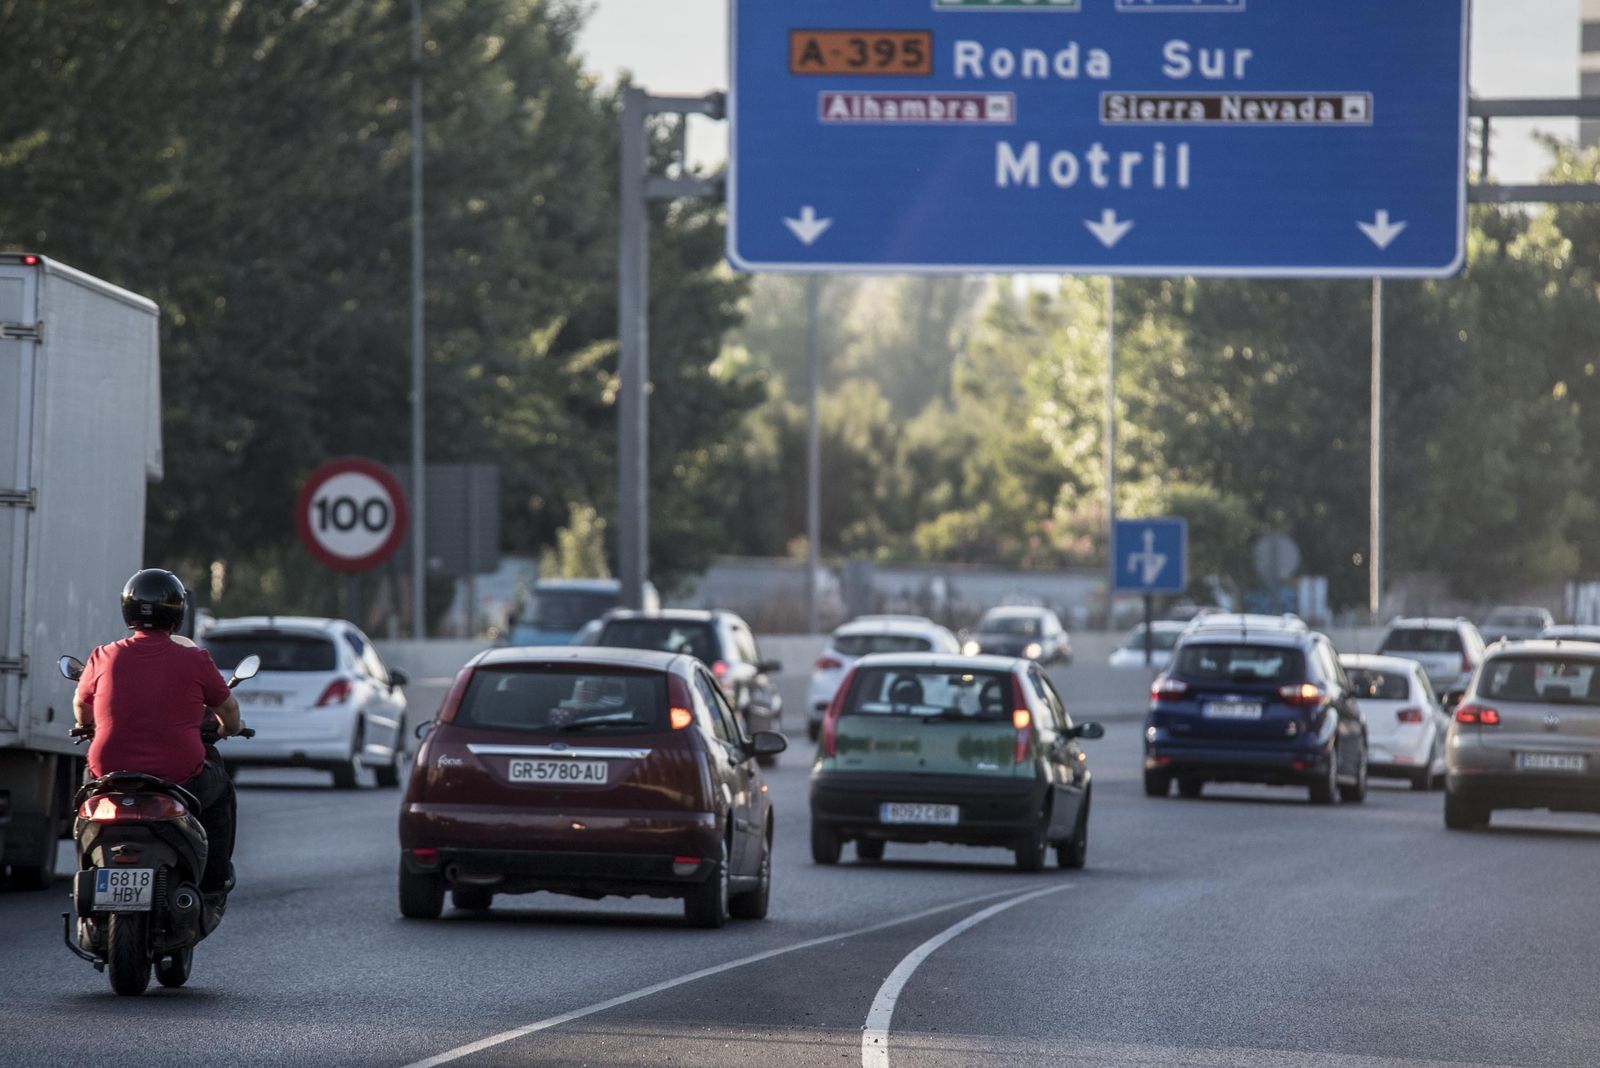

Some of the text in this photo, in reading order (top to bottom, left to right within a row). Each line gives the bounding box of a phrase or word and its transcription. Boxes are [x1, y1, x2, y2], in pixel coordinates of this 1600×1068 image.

[799, 37, 925, 68] A-395
[953, 39, 1252, 79] Ronda Sur
[827, 94, 980, 119] Alhambra
[1108, 95, 1335, 122] Sierra Nevada
[995, 141, 1190, 189] Motril
[314, 496, 389, 533] 100
[511, 761, 606, 781] GR-5780-AU
[110, 871, 150, 886] 6818
[113, 887, 143, 902] HBY
